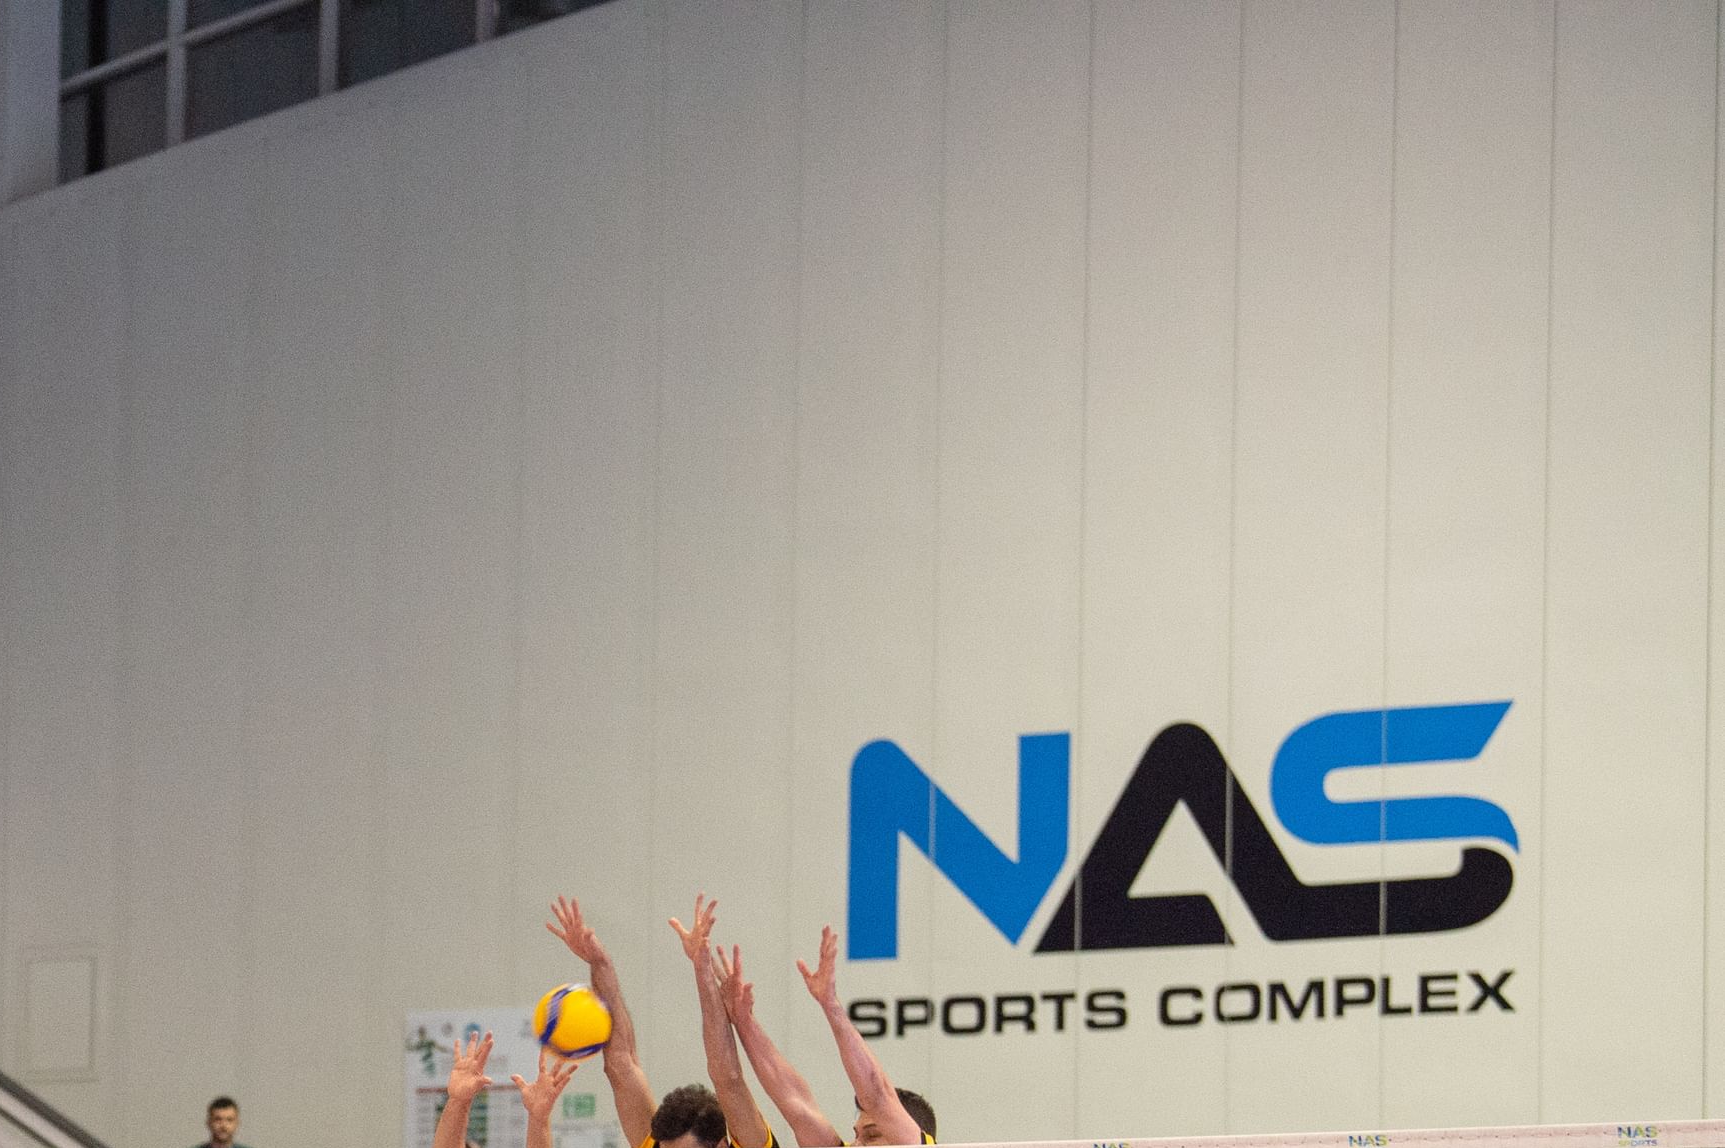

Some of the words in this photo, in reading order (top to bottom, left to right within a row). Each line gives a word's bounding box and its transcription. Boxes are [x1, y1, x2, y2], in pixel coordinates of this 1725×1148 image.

[846, 697, 1521, 962] NAS
[847, 988, 1129, 1040] SPORTS
[1157, 969, 1517, 1029] COMPLEX
[1348, 1134, 1388, 1147] NAS
[1617, 1125, 1658, 1138] NAS
